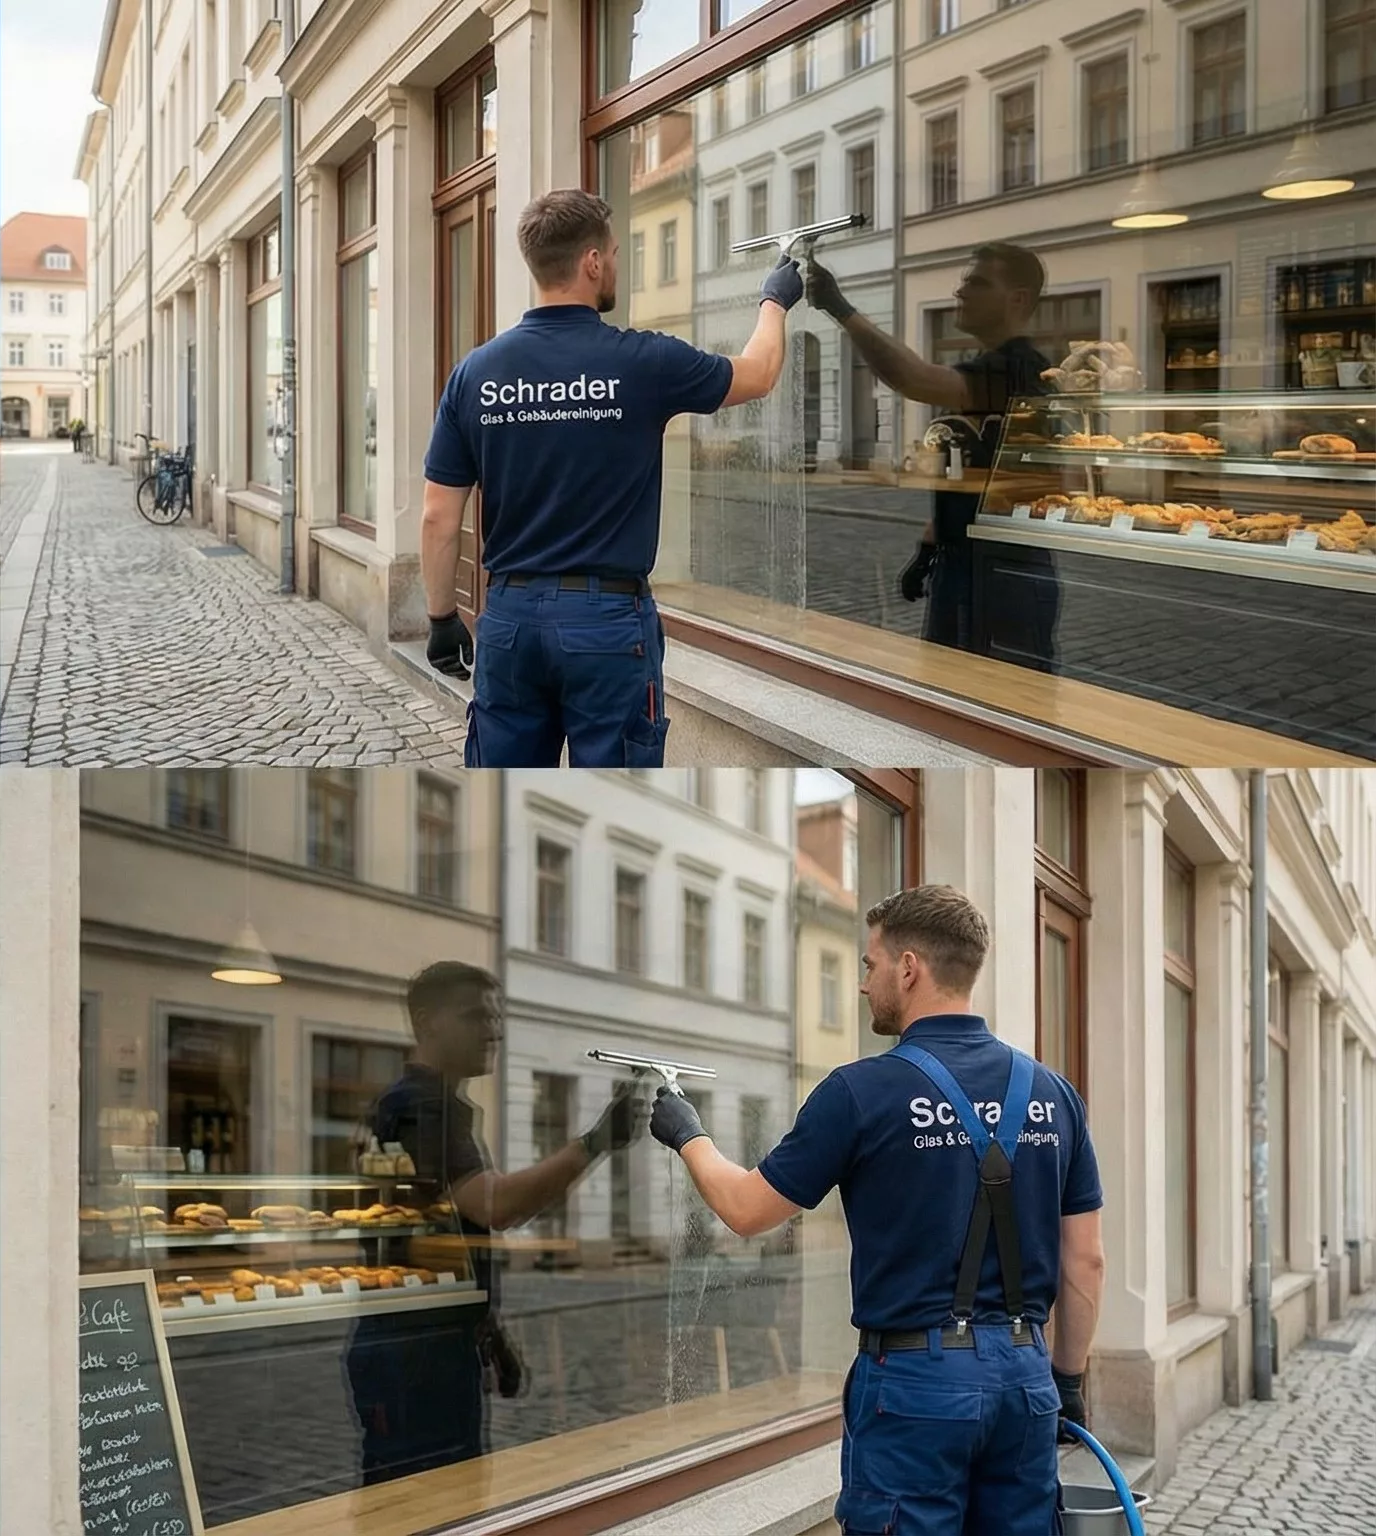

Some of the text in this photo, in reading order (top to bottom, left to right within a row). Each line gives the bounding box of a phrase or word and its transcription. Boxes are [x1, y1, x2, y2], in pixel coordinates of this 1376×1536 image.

[480, 374, 620, 407] Schrader
[506, 411, 515, 423] &
[909, 1097, 1055, 1128] Scraer
[913, 1133, 942, 1149] Glas
[945, 1131, 955, 1146] &
